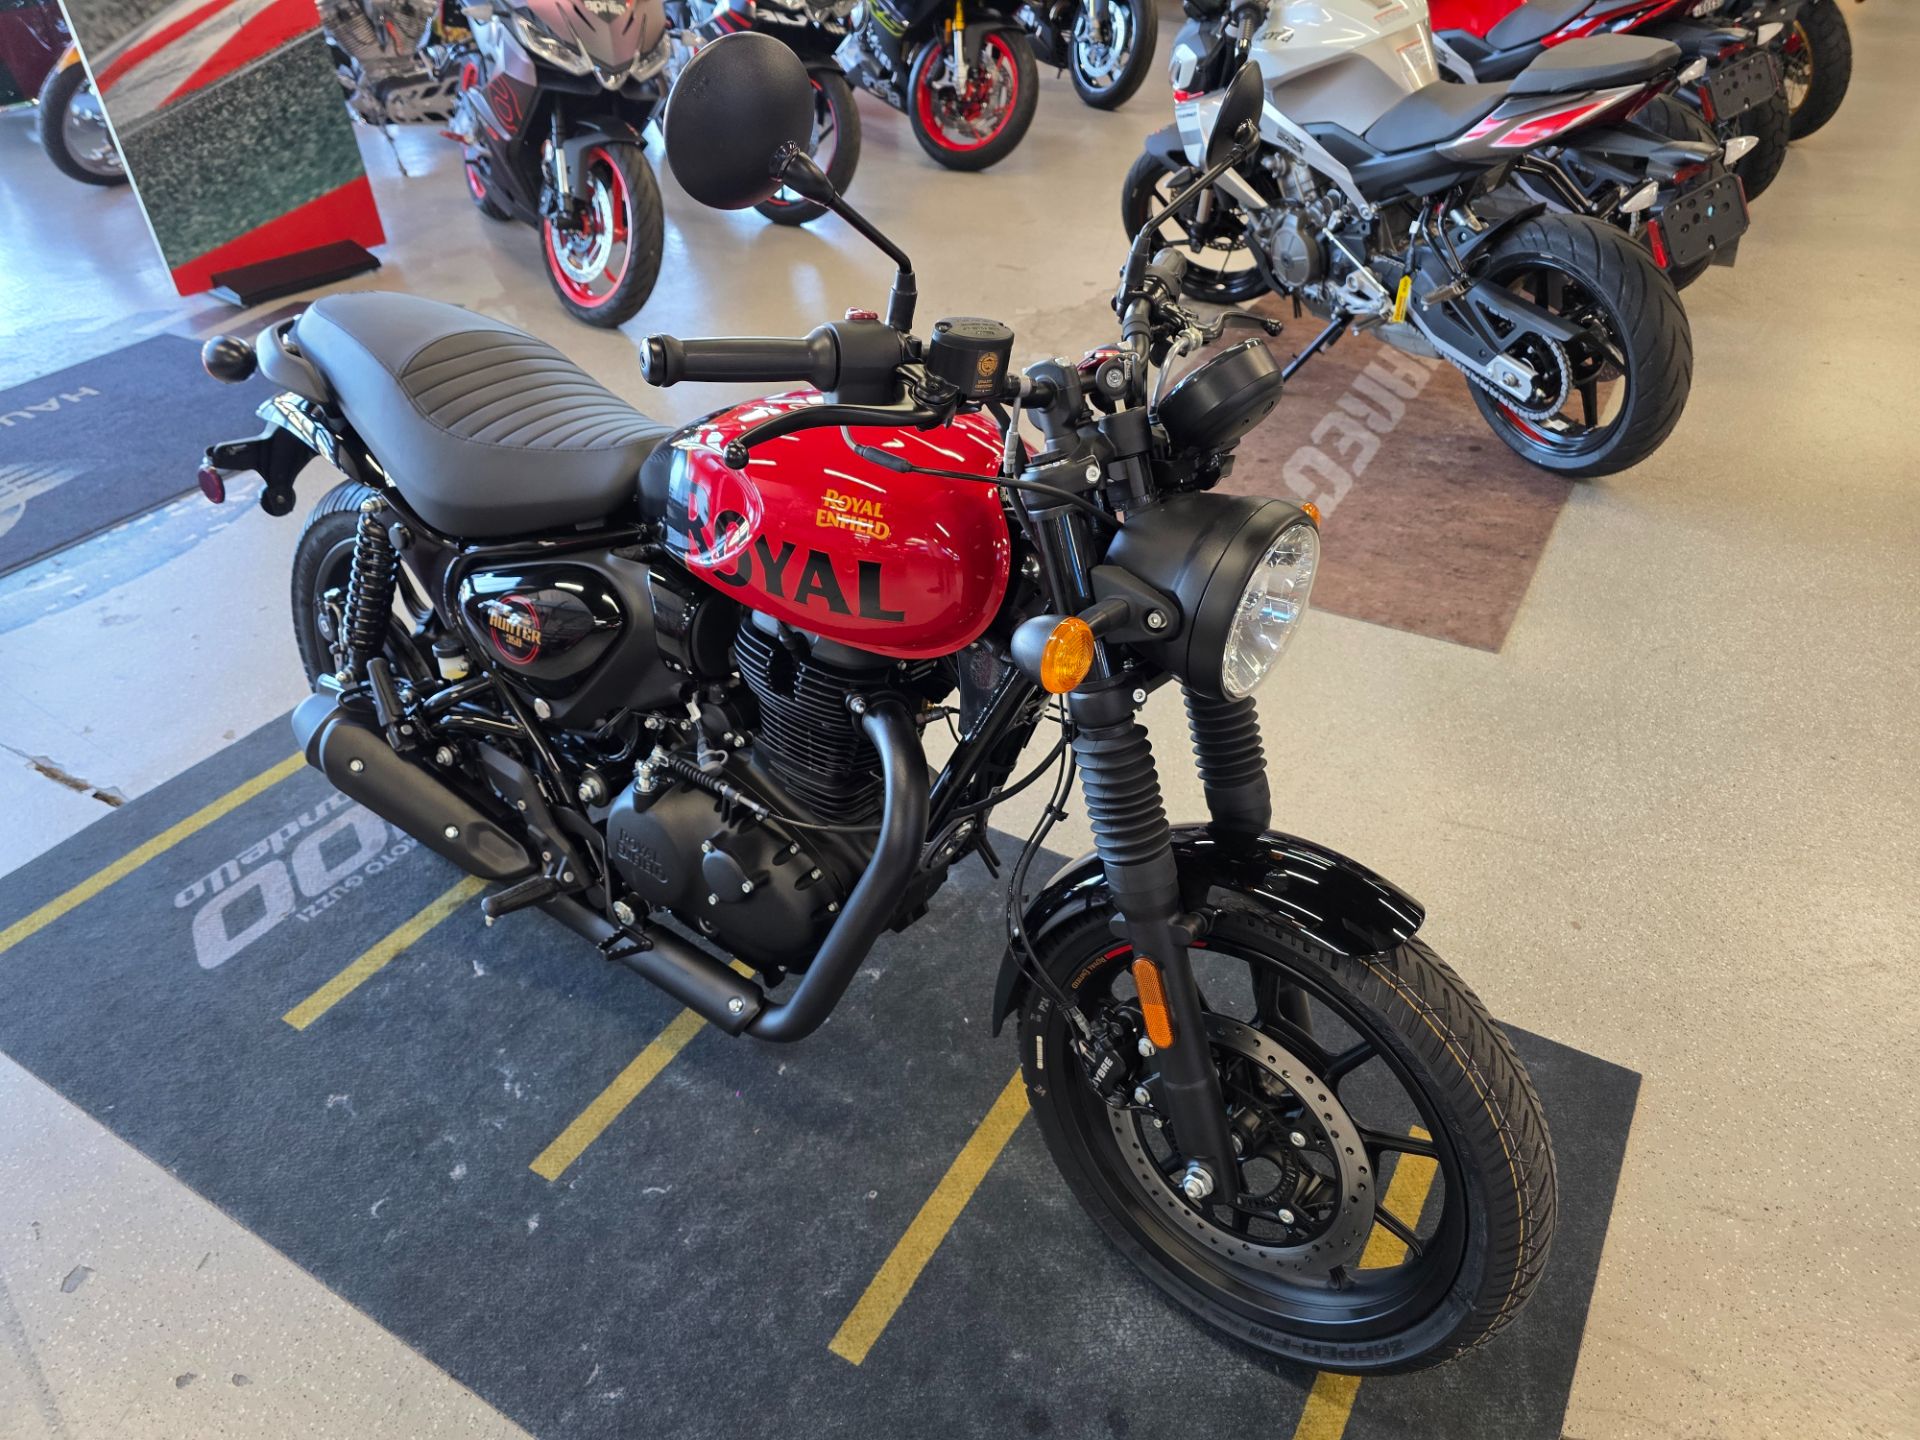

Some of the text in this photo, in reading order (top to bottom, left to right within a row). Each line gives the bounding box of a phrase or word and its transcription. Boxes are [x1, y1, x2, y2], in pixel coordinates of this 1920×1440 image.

[815, 508, 891, 541] ENFIELD
[822, 488, 884, 519] ROYAL
[668, 482, 905, 622] ROYAL
[191, 805, 411, 970] 00
[296, 875, 364, 922] GUZZI
